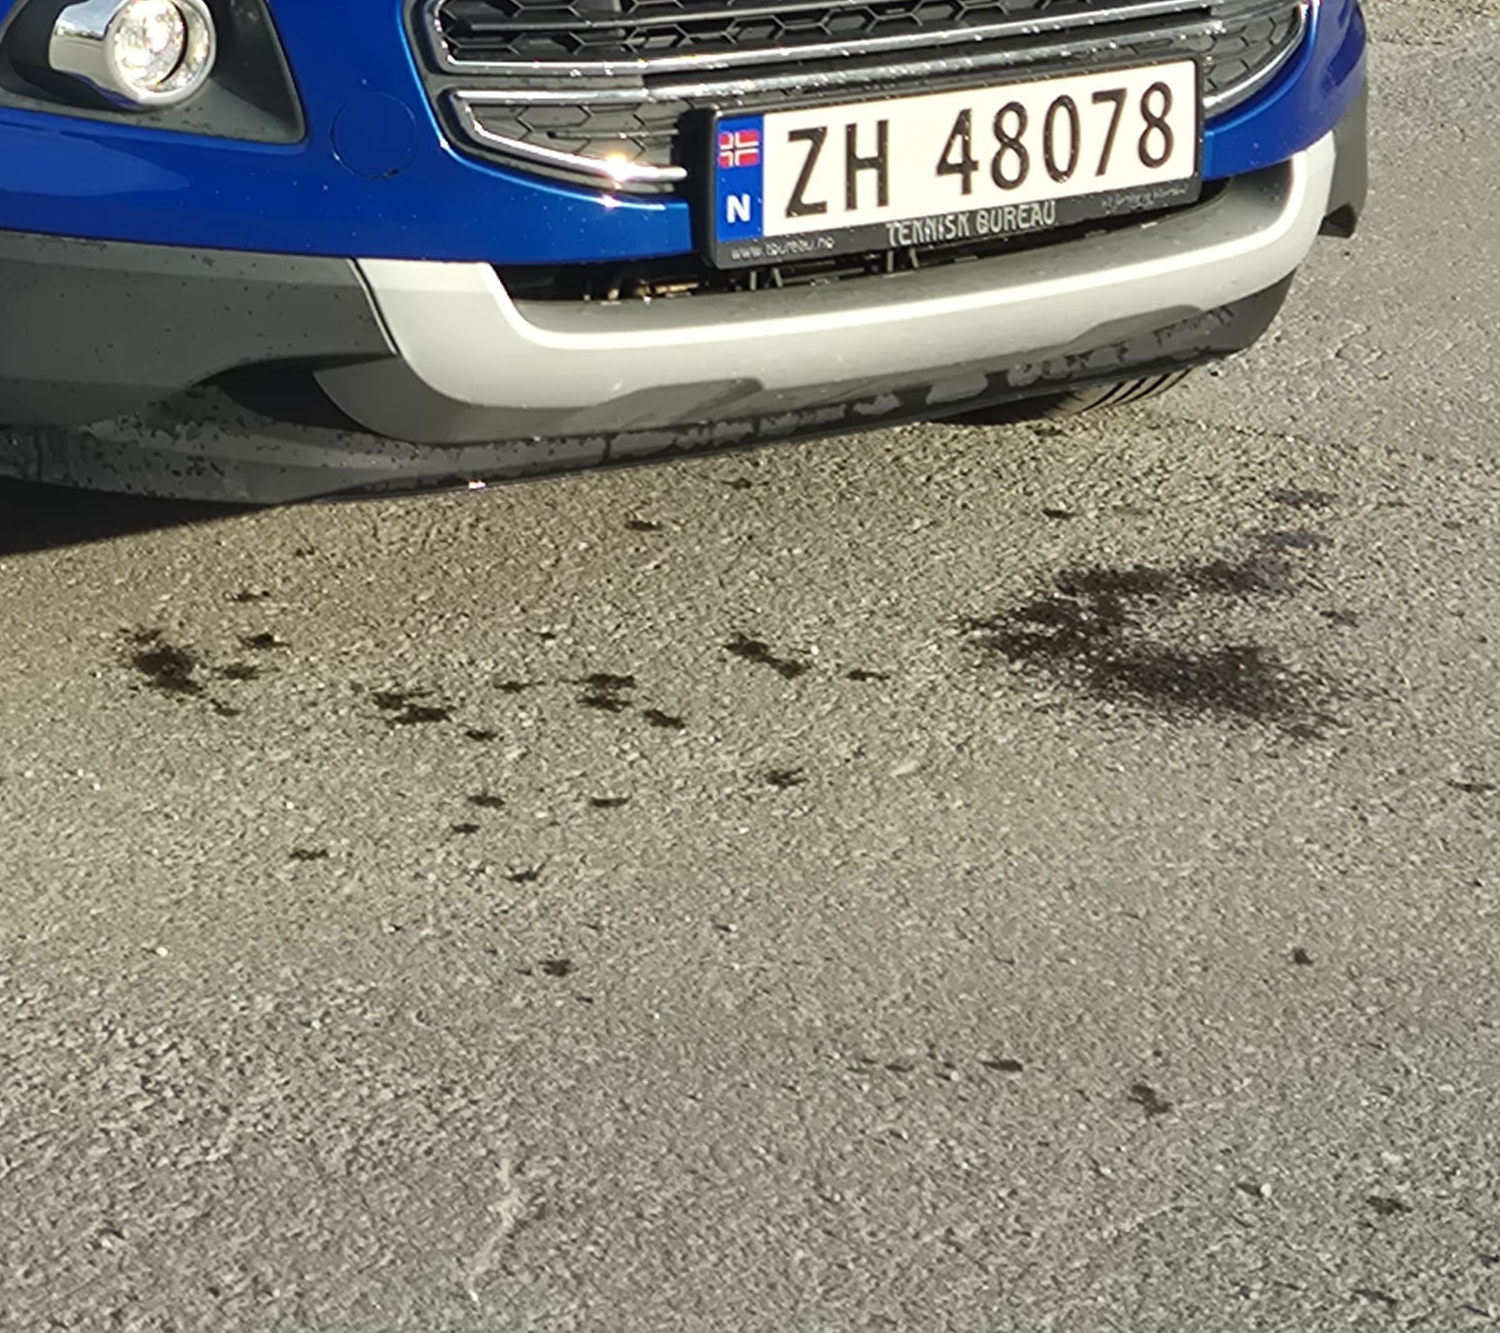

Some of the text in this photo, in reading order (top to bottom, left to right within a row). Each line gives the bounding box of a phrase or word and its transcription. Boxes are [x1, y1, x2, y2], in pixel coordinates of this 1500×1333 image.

[784, 80, 1174, 219] ZH 48078
[726, 193, 751, 224] N
[975, 200, 1056, 235] BUREAU
